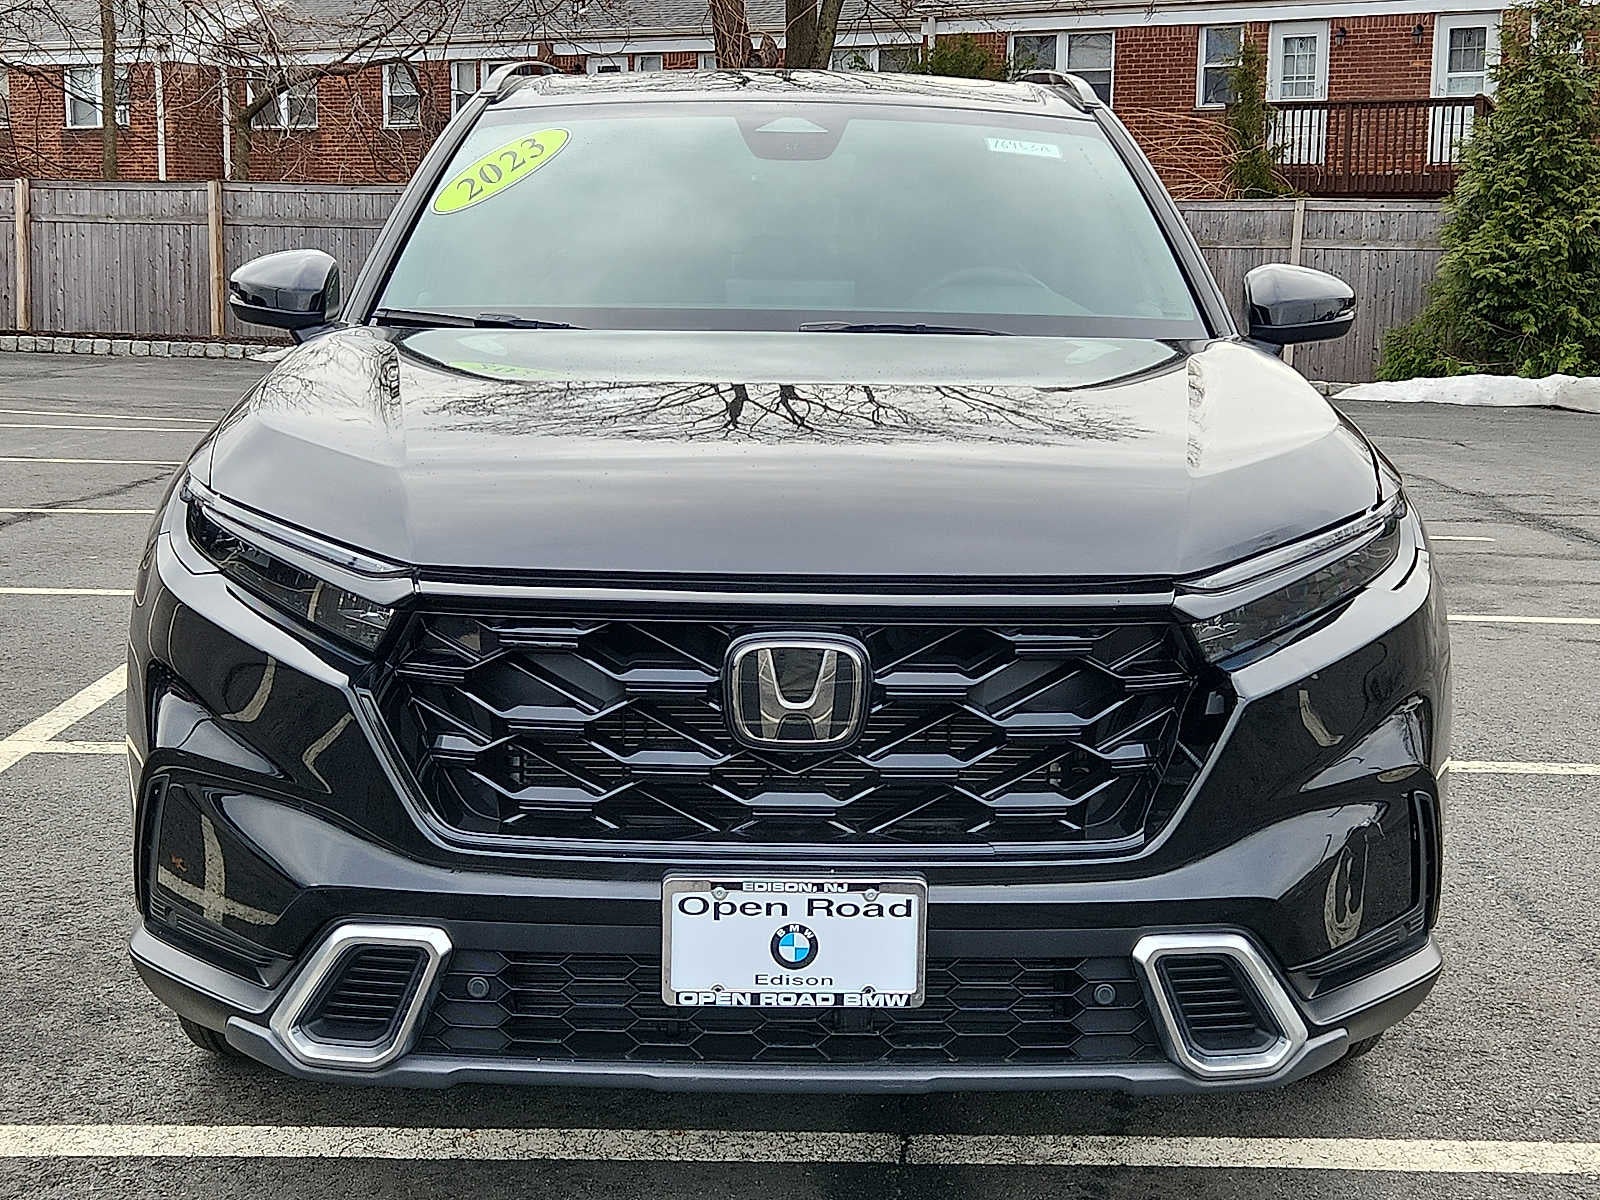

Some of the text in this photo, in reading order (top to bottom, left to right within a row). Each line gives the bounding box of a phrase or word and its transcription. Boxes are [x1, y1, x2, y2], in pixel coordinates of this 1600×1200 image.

[456, 138, 545, 200] 2023
[742, 882, 849, 893] EDISON, NJ
[678, 896, 913, 920] Open Road
[776, 924, 814, 939] BMW
[755, 974, 833, 986] Edison
[678, 992, 909, 1007] OPEN ROAD BMW
